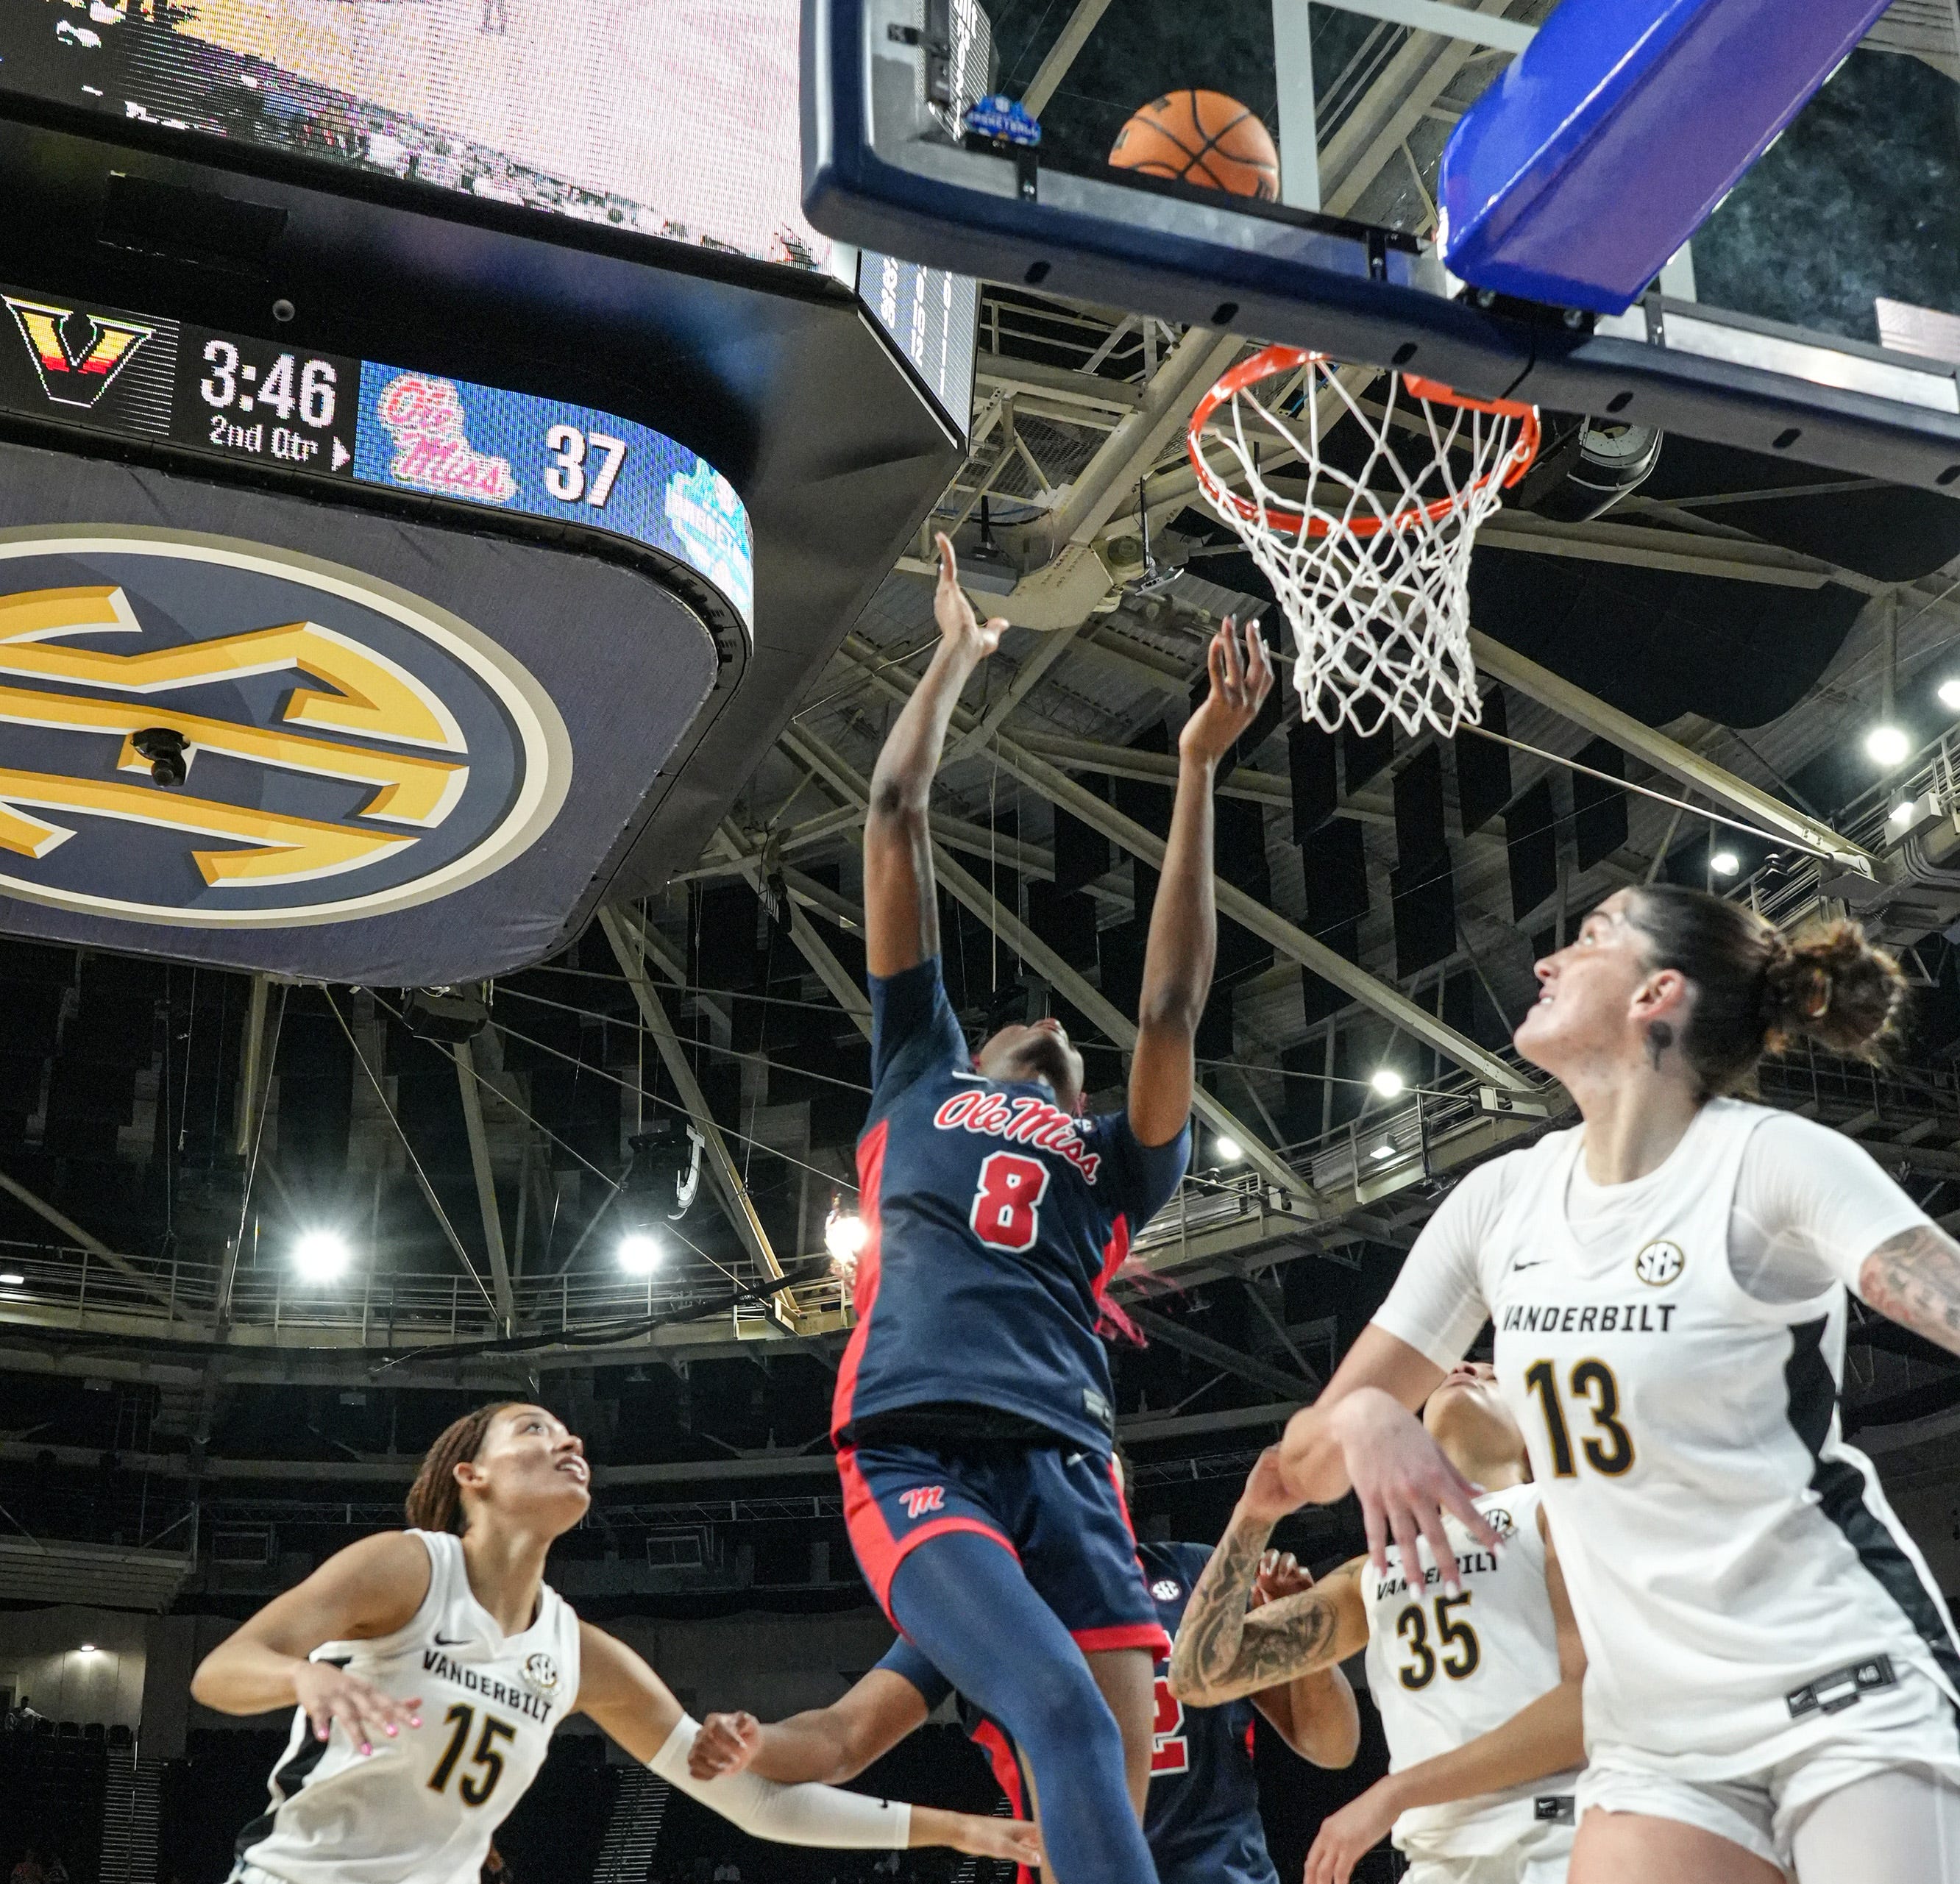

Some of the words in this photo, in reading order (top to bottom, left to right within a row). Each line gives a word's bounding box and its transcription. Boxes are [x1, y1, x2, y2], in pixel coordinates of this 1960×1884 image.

[200, 340, 337, 428] 3:46
[209, 414, 263, 452] 2nd
[270, 427, 319, 461] Qtr
[545, 424, 627, 510] 37
[969, 1150, 1051, 1253] 8
[1504, 1304, 1676, 1332] VANDERBILT
[1524, 1357, 1636, 1479] 13
[1397, 1592, 1481, 1691] 35
[422, 1648, 552, 1725] VANDERBILT
[427, 1702, 517, 1807] 15
